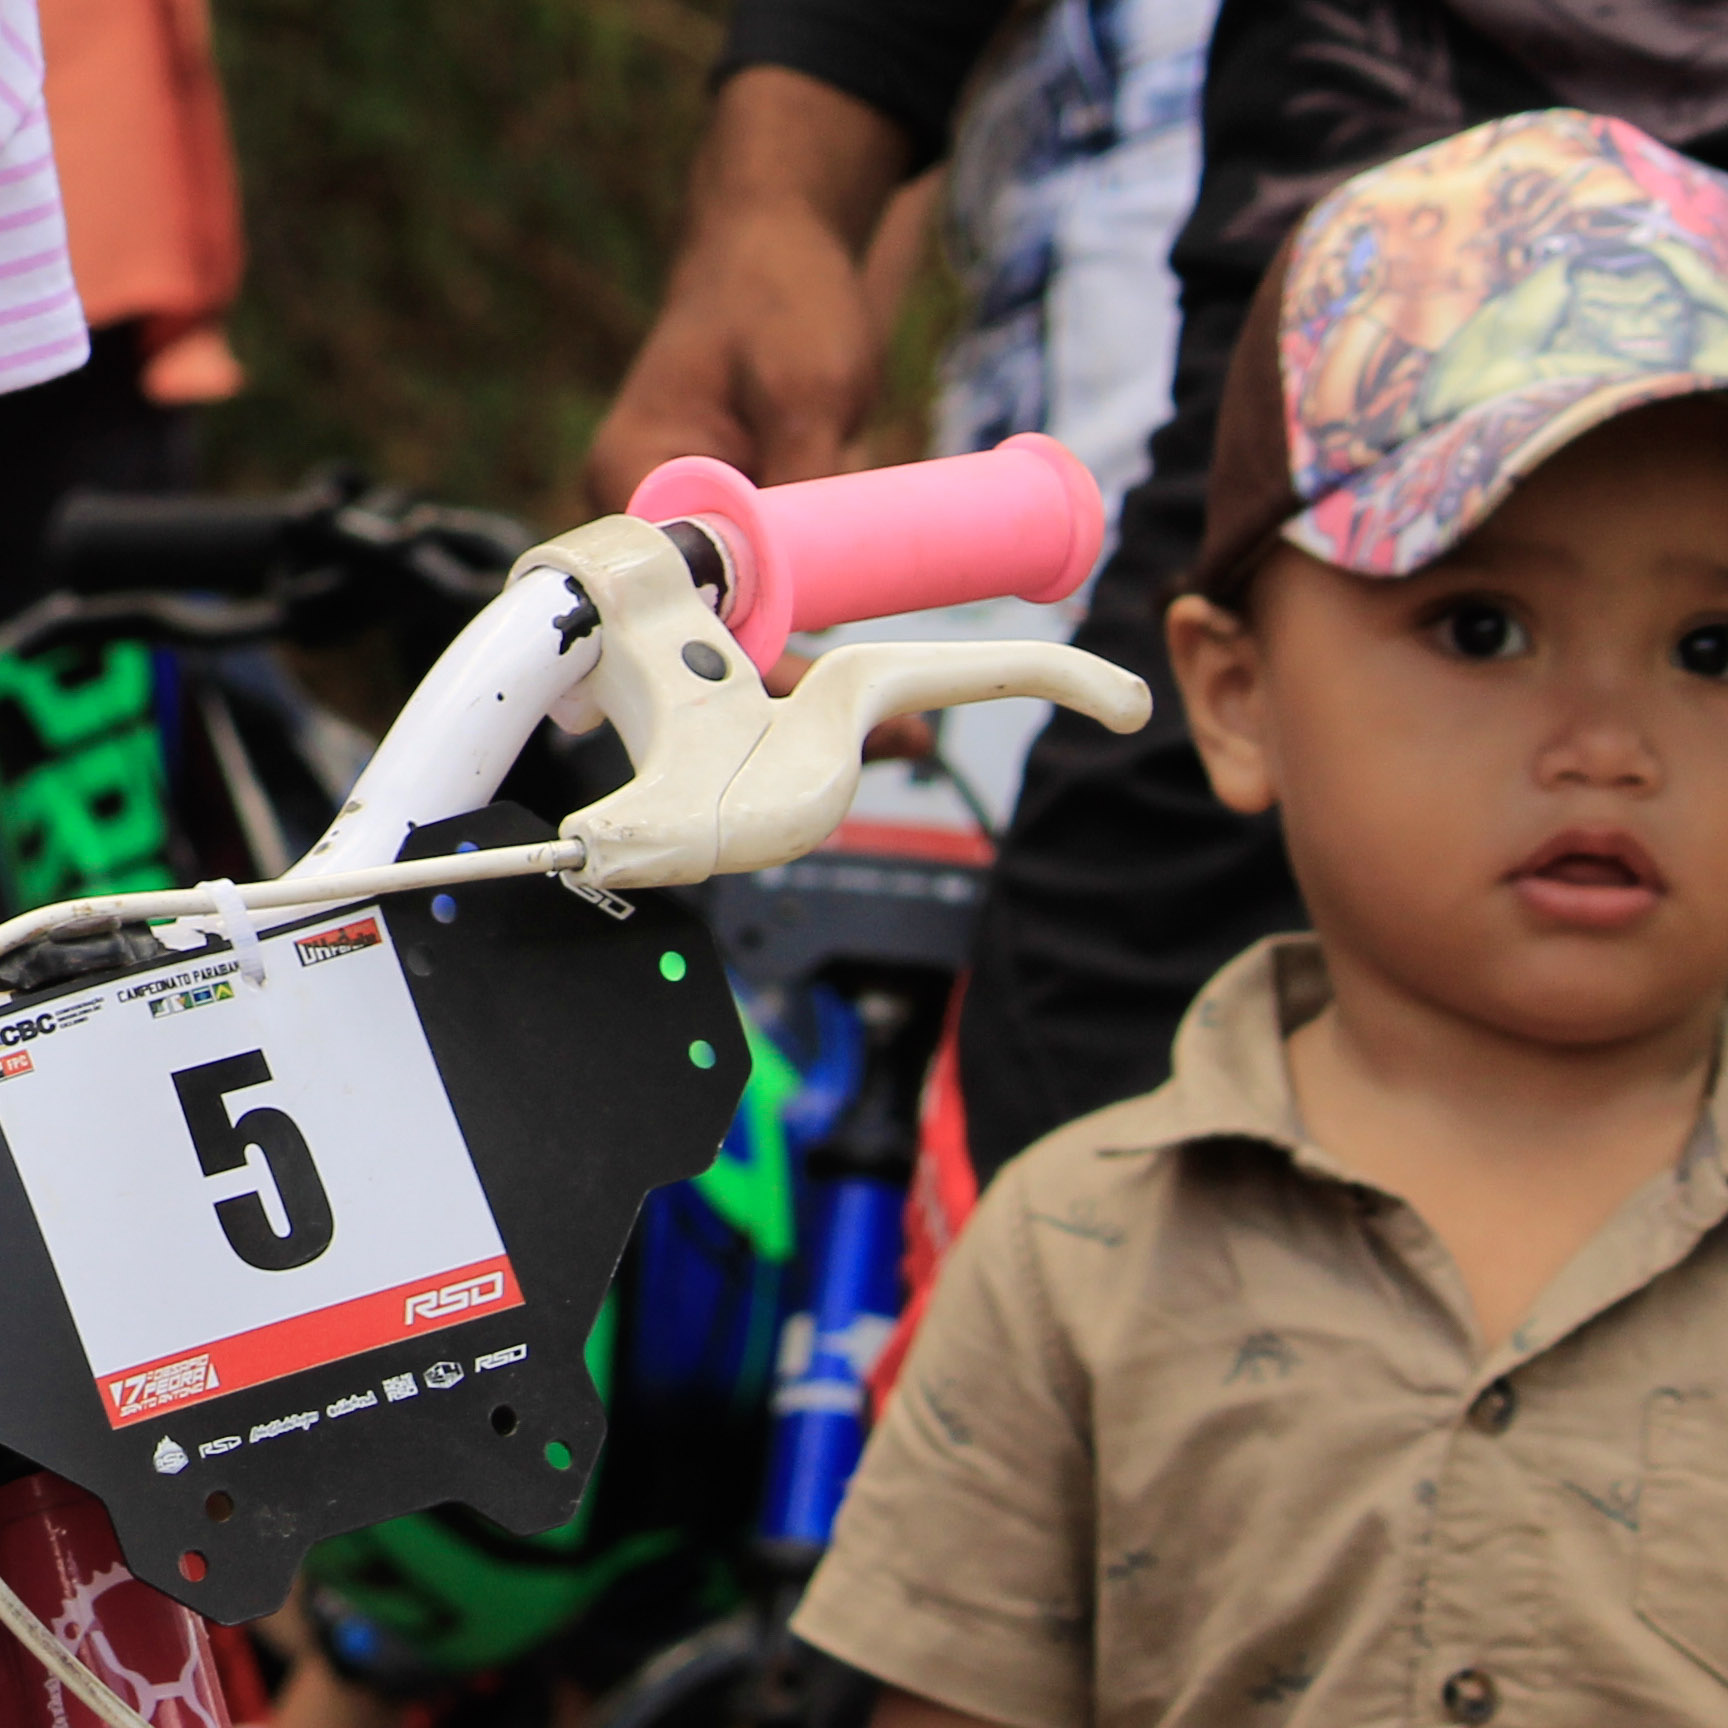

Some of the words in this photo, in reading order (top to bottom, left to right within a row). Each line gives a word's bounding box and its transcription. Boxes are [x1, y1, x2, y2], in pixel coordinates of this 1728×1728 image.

[116, 972, 192, 1004] CAMPEONATO
[0, 1013, 57, 1046] CBC
[171, 1049, 336, 1272] 5
[404, 1270, 504, 1326] RSD
[474, 1343, 528, 1373] RSD
[142, 1366, 207, 1400] PEDRA
